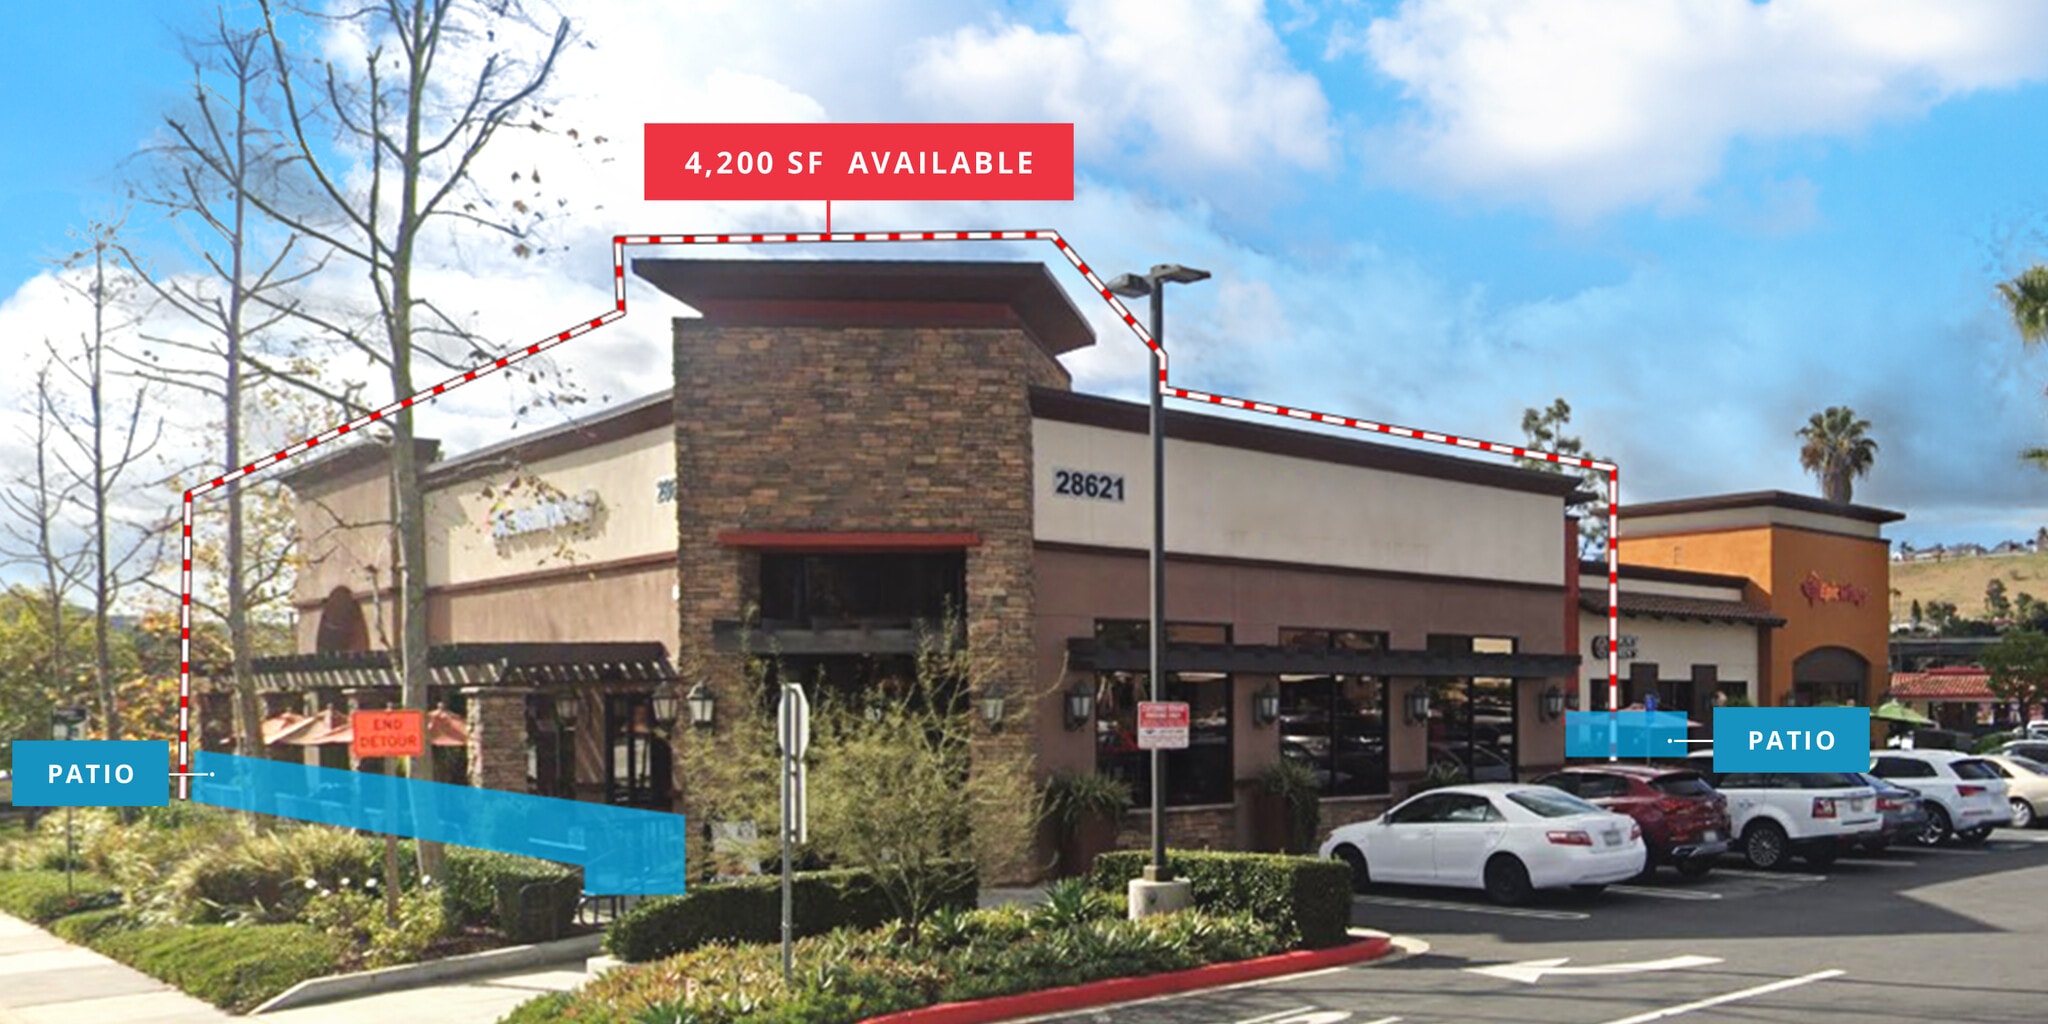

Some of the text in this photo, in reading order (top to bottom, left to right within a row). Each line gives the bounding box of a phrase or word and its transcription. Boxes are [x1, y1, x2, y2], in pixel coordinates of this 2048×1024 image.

[1055, 470, 1124, 501] 28621
[373, 718, 403, 731] END
[359, 734, 418, 748] DETOUR
